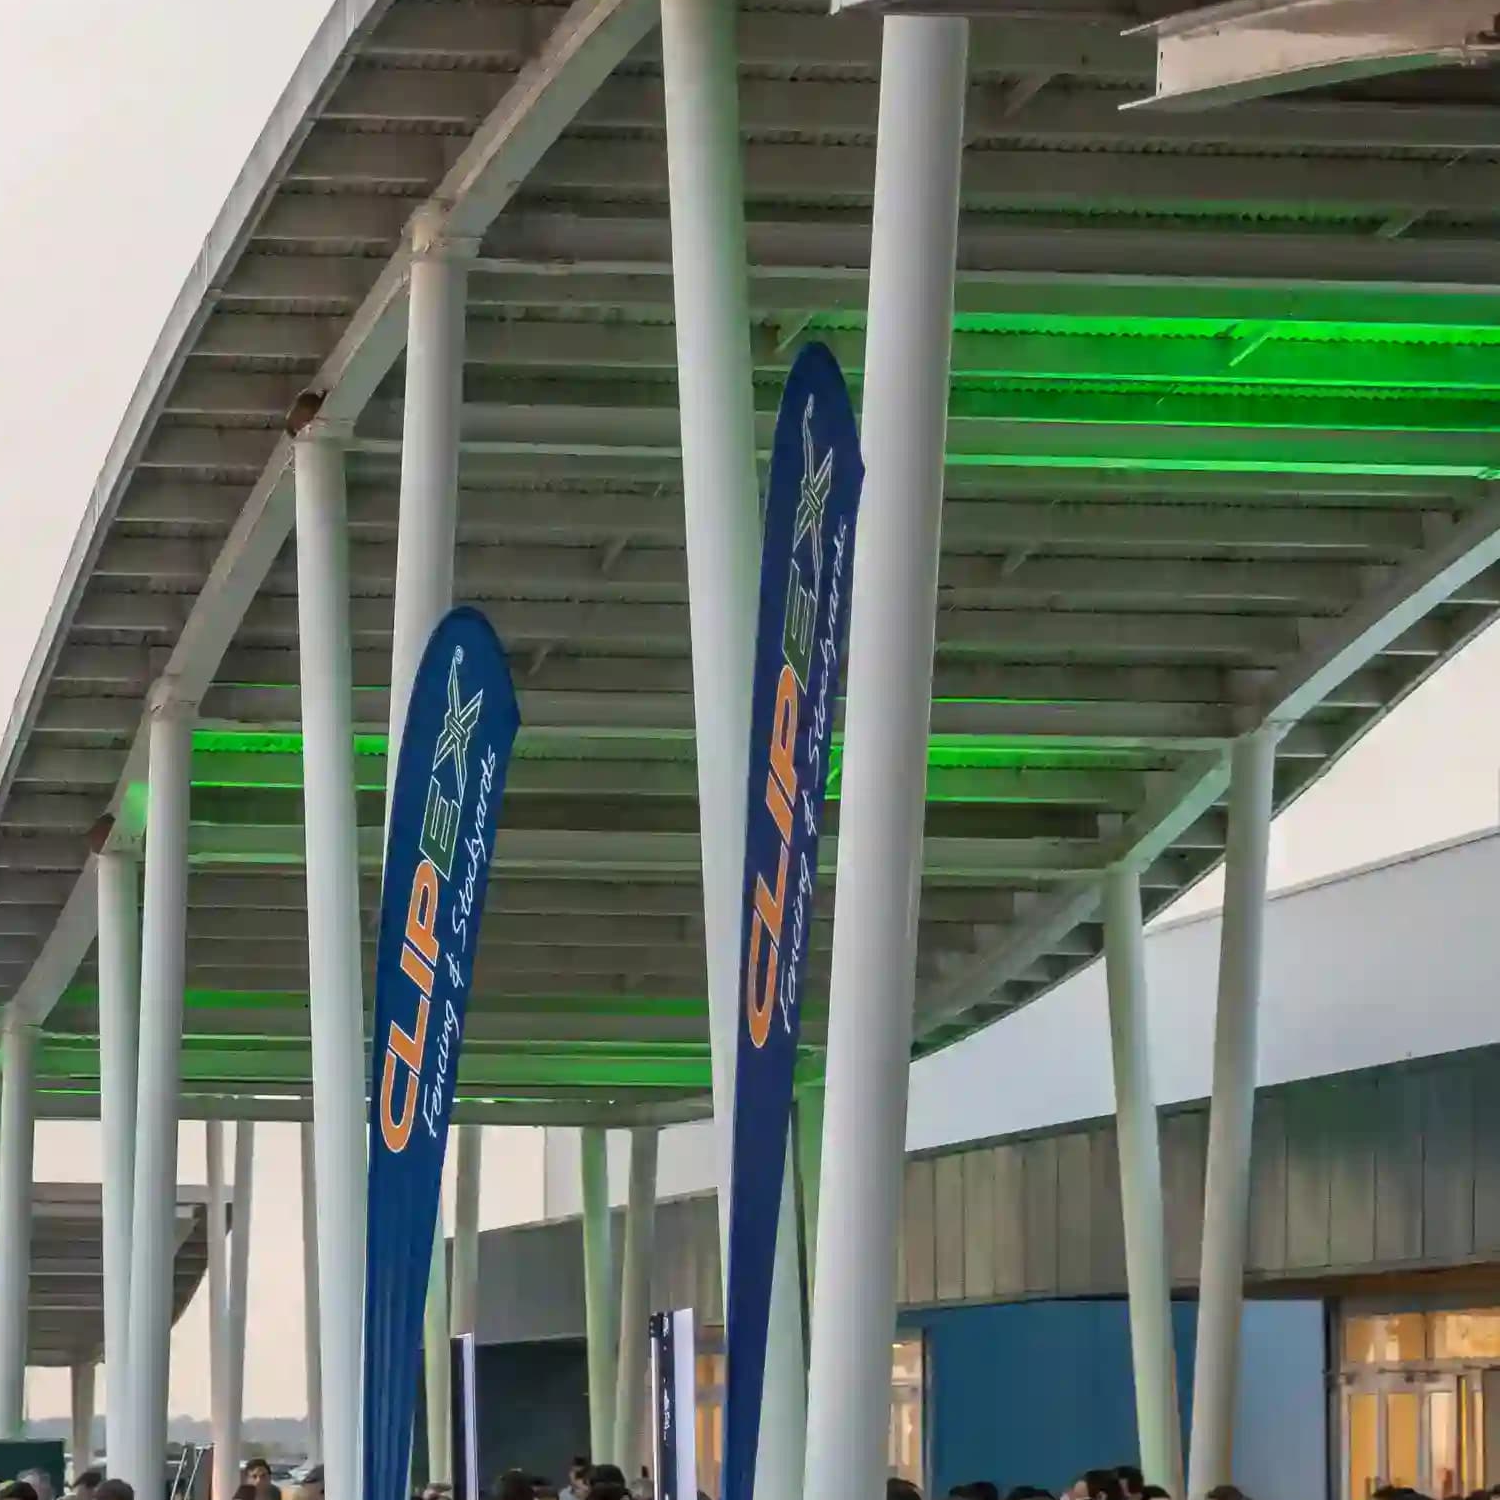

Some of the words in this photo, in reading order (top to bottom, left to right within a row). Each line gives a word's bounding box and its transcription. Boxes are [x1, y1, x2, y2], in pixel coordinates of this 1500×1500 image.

[748, 410, 834, 1048] CLIPEX
[379, 656, 484, 1154] CLIPEX
[452, 743, 497, 952] Stockyards
[779, 851, 813, 1035] Fencing
[445, 952, 465, 989] &
[422, 999, 461, 1139] Fencing
